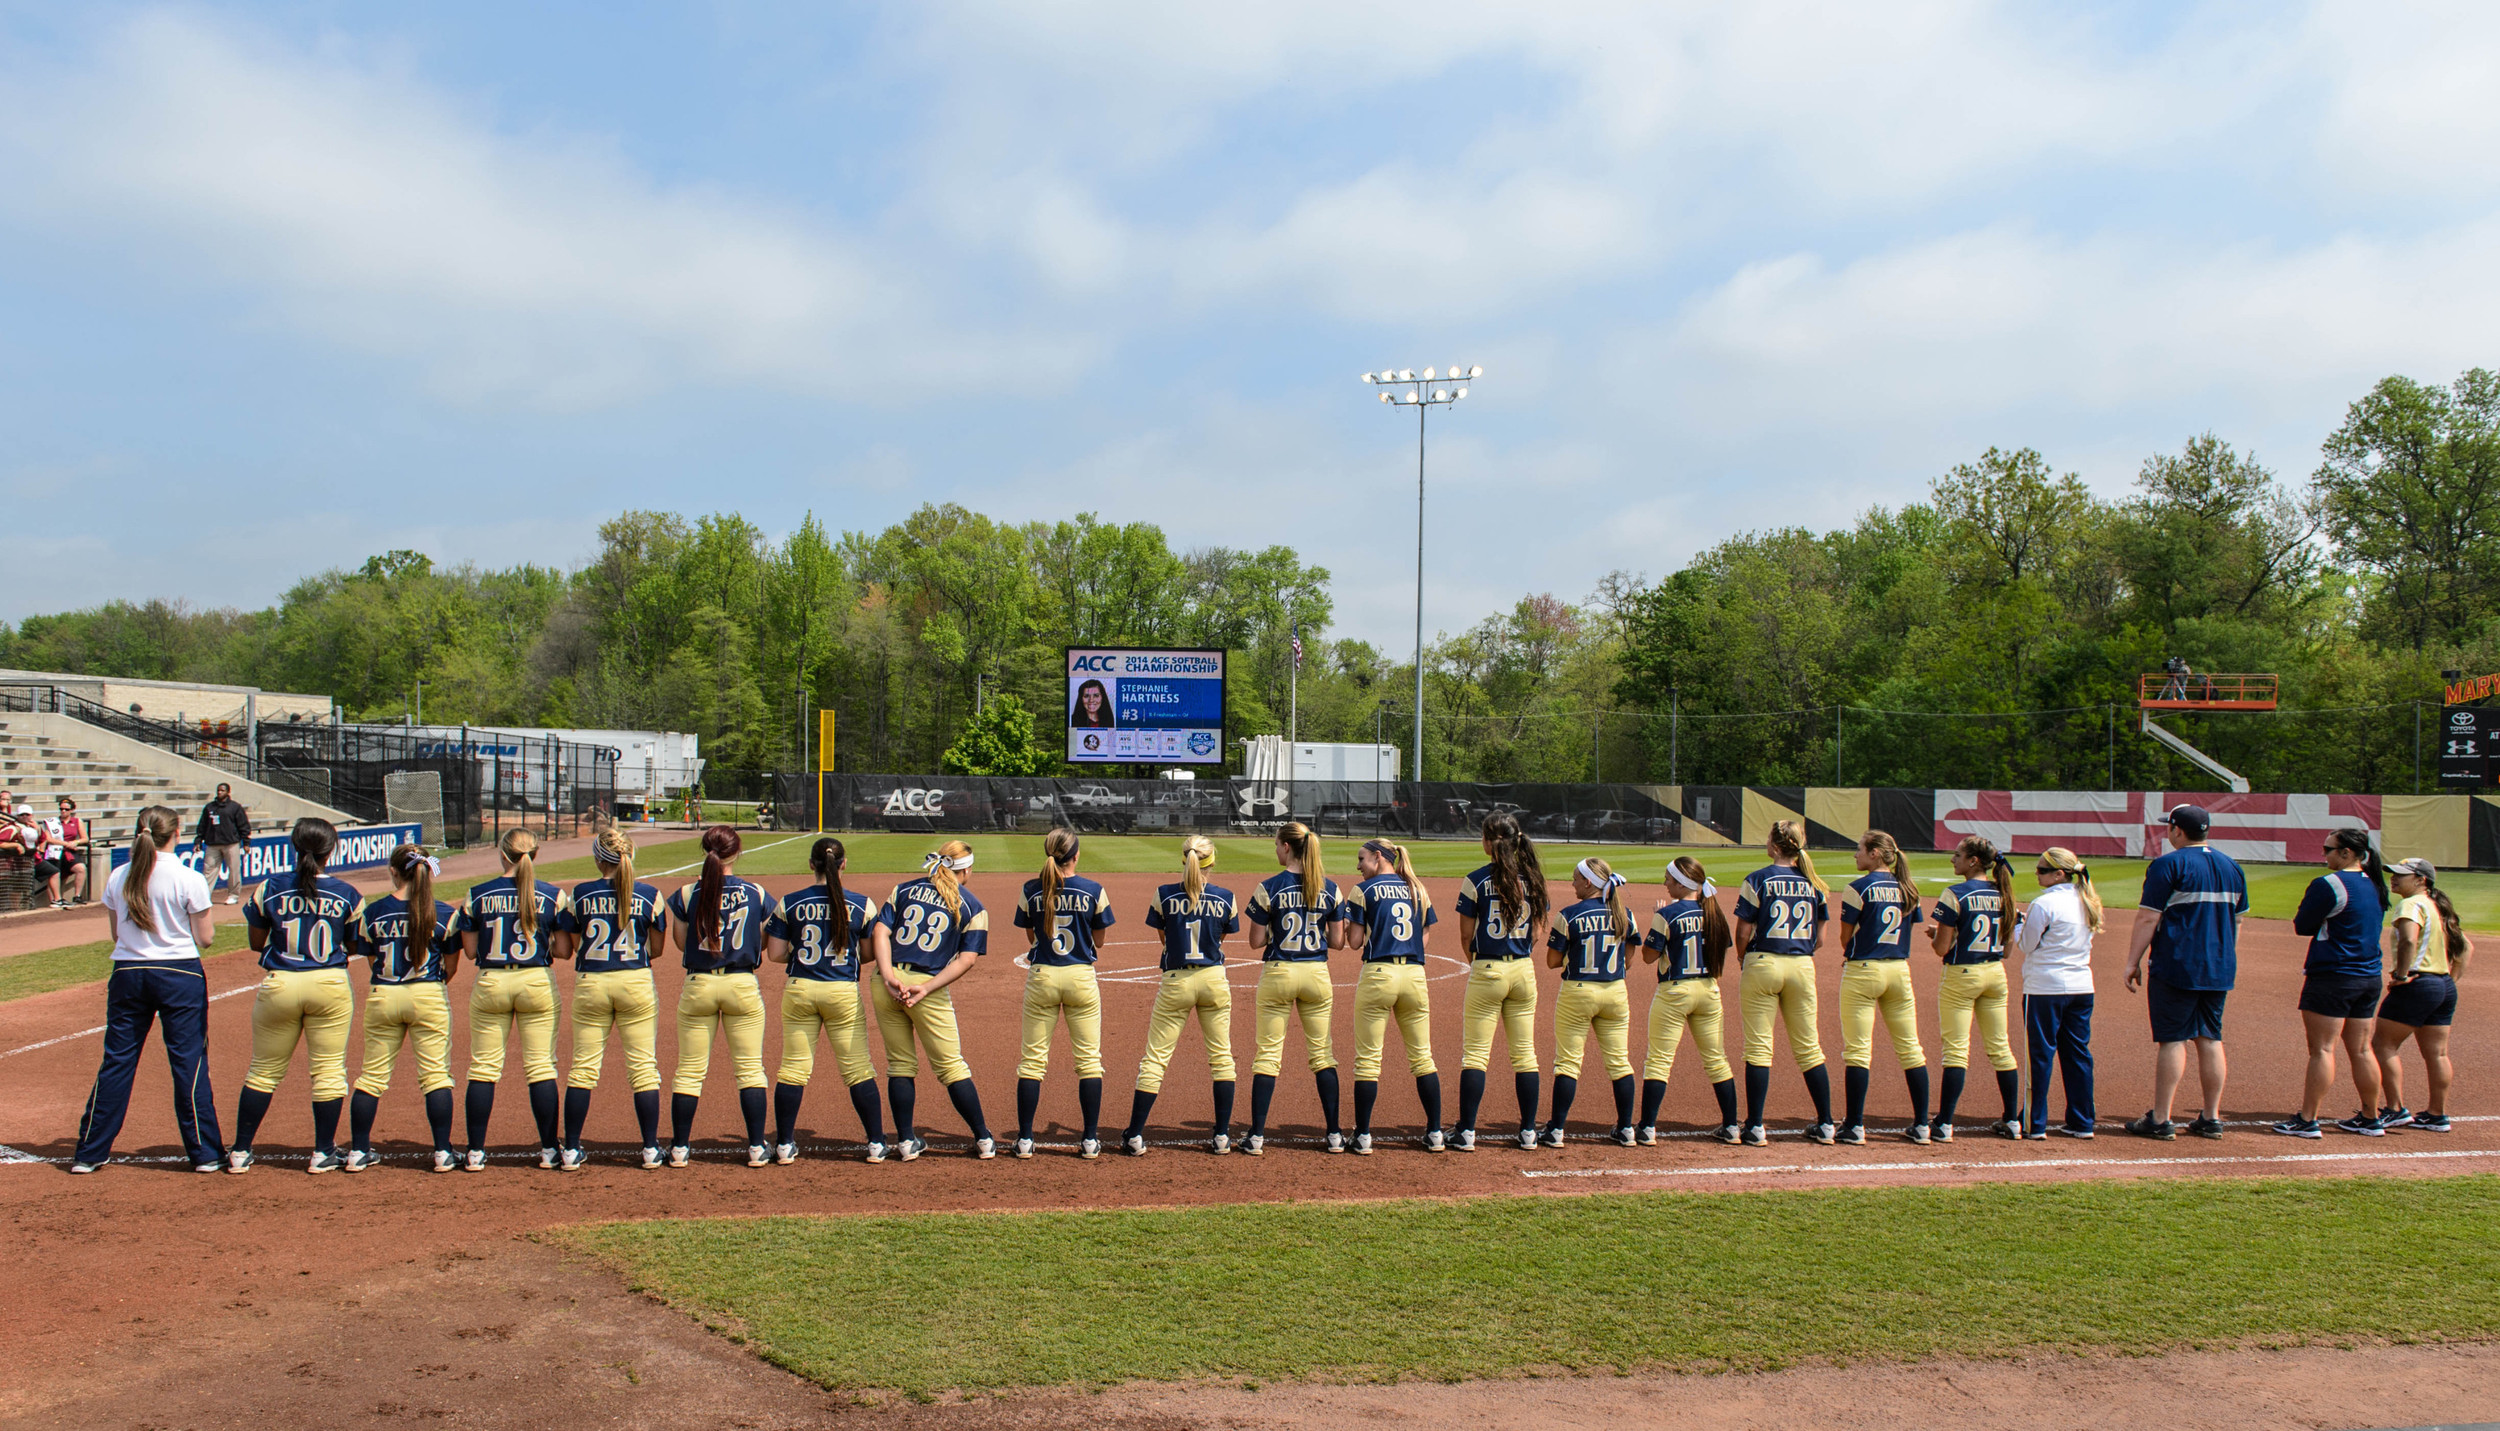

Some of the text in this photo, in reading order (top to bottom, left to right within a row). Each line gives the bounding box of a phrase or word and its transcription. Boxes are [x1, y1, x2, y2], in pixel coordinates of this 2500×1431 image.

[1072, 656, 1116, 672] ACC
[1125, 656, 1148, 664] 2014
[1172, 657, 1218, 665] SOFTBALL
[1125, 664, 1218, 673] CHAMPIONSHIP
[1121, 684, 1169, 693] STEPHANIE
[1121, 693, 1180, 704] HARTNESS
[1121, 708, 1139, 721] #3
[595, 748, 622, 761] HD
[1193, 733, 1210, 741] ACC
[884, 788, 944, 811] ACC
[277, 895, 345, 918] JONES
[1169, 898, 1225, 918] DOWNS
[1391, 901, 1413, 942] 3
[1486, 899, 1531, 939] 52
[1766, 900, 1813, 939] 22
[1877, 905, 1903, 946] 2
[281, 917, 334, 964] 10
[486, 916, 538, 961] 13
[584, 917, 641, 962] 24
[797, 924, 850, 967] 34
[895, 903, 950, 953] 33
[1051, 914, 1076, 957] 5
[1185, 919, 1205, 960] 1
[1280, 911, 1323, 952] 25
[1579, 935, 1622, 974] 17
